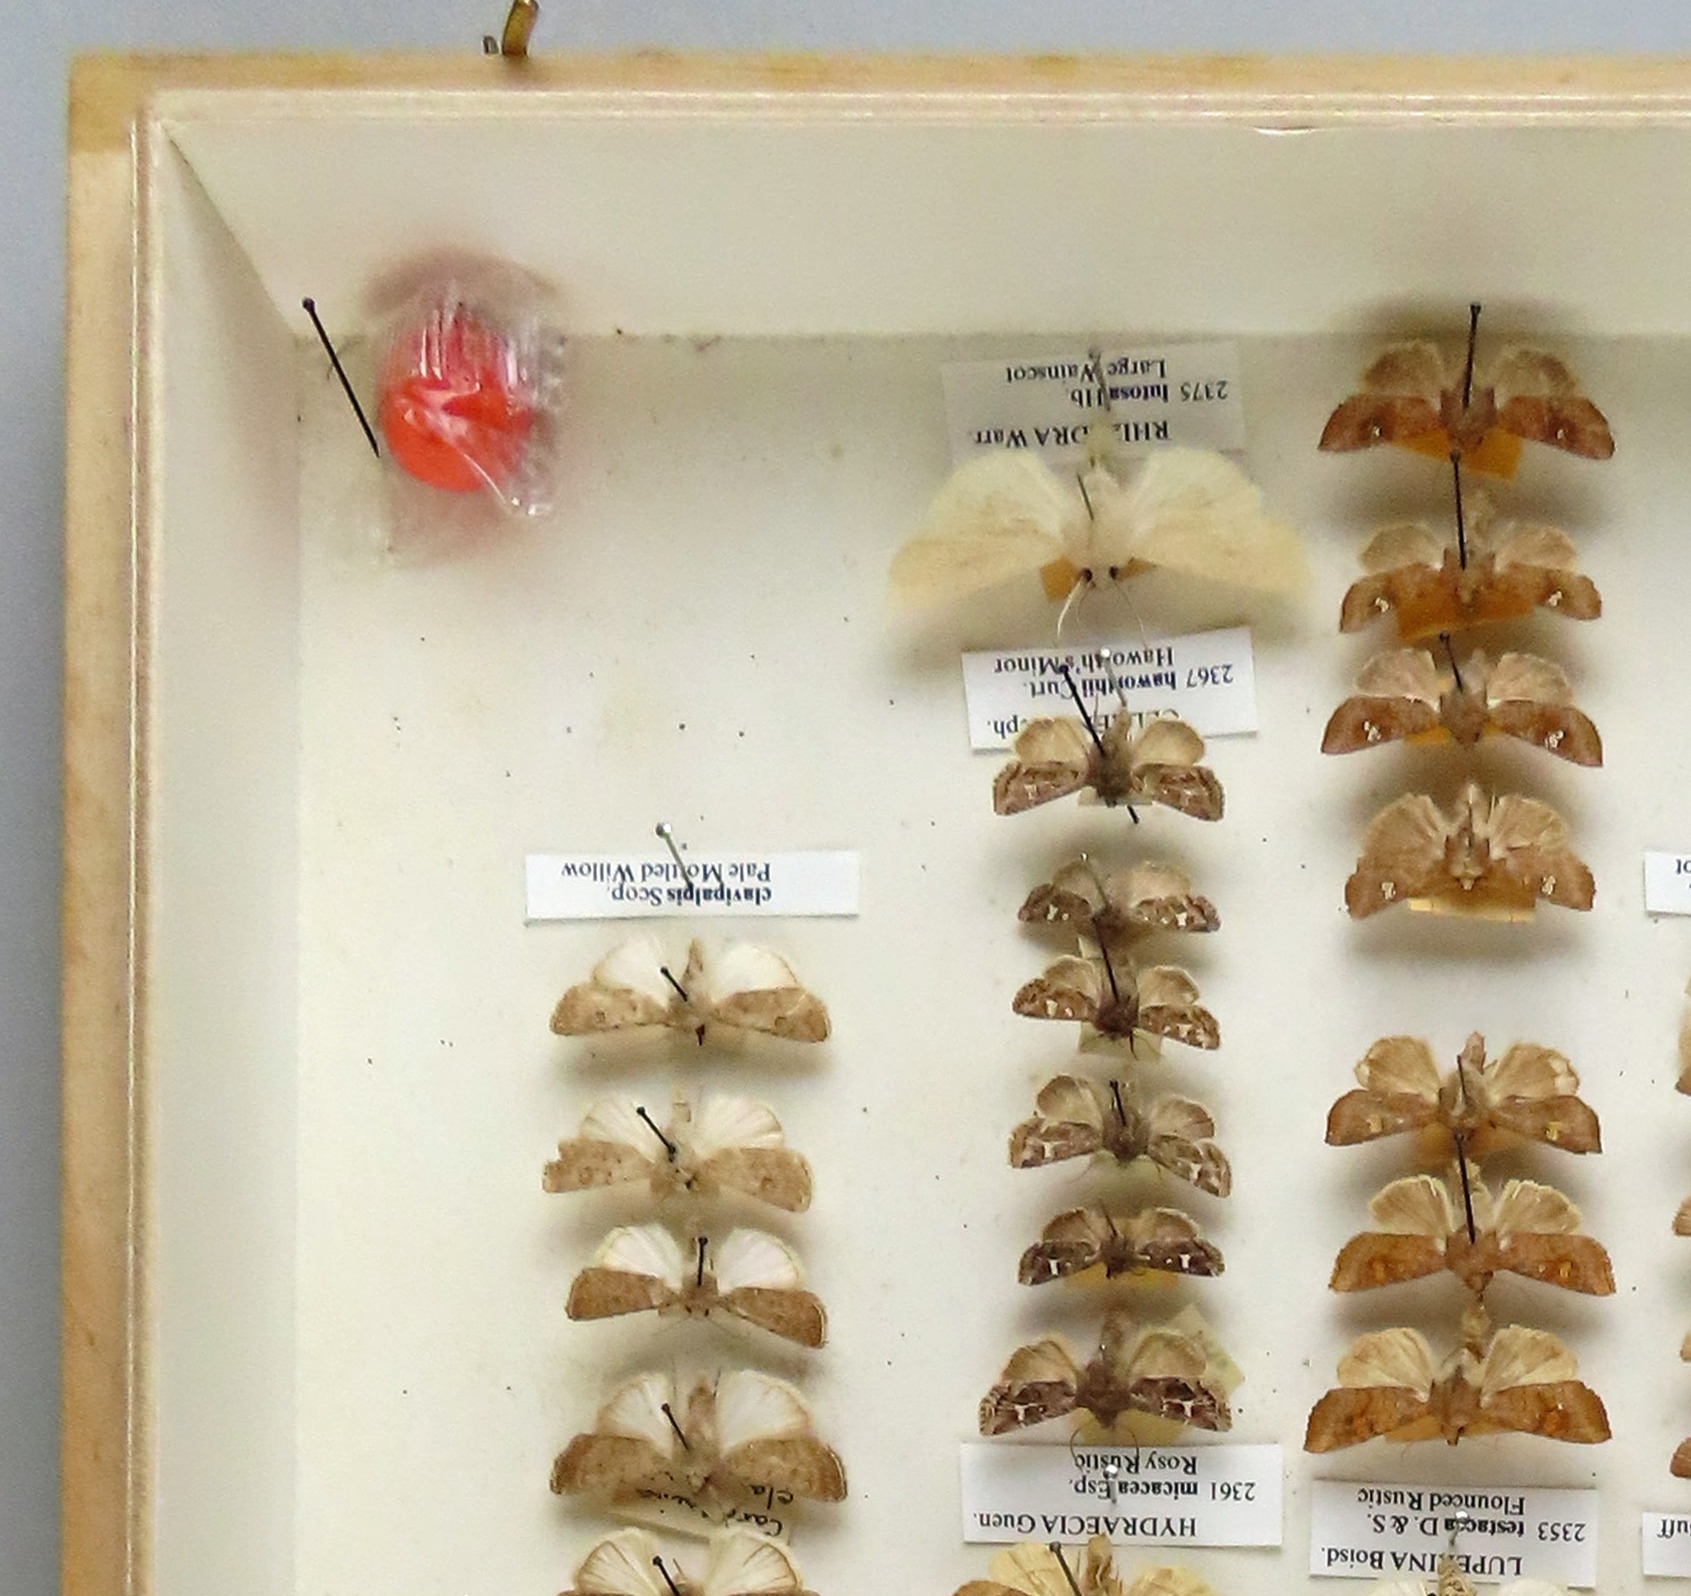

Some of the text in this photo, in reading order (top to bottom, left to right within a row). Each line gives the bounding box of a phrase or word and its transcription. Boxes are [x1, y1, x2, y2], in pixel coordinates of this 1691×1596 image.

[1107, 357, 1165, 378] Large
[1110, 384, 1168, 404] lutosa
[1180, 381, 1227, 402] 2375
[994, 656, 1059, 676] Minor
[1187, 664, 1234, 686] 2367
[561, 863, 633, 882] Willow
[728, 863, 771, 881] Pale
[608, 884, 772, 905] clavipalpis Scop.
[1073, 1452, 1197, 1475] Rosy Rustic
[1118, 1481, 1198, 1500] micacea
[1210, 1482, 1256, 1500] 2361
[1358, 1488, 1525, 1515] Flounced Rustic
[973, 1513, 1196, 1536] HYDRAECIA Guen.
[1368, 1514, 1385, 1532] S.
[1390, 1516, 1408, 1533] &
[1415, 1516, 1438, 1535] D.
[1537, 1522, 1586, 1542] 2353
[1322, 1547, 1384, 1569] Boisd.
